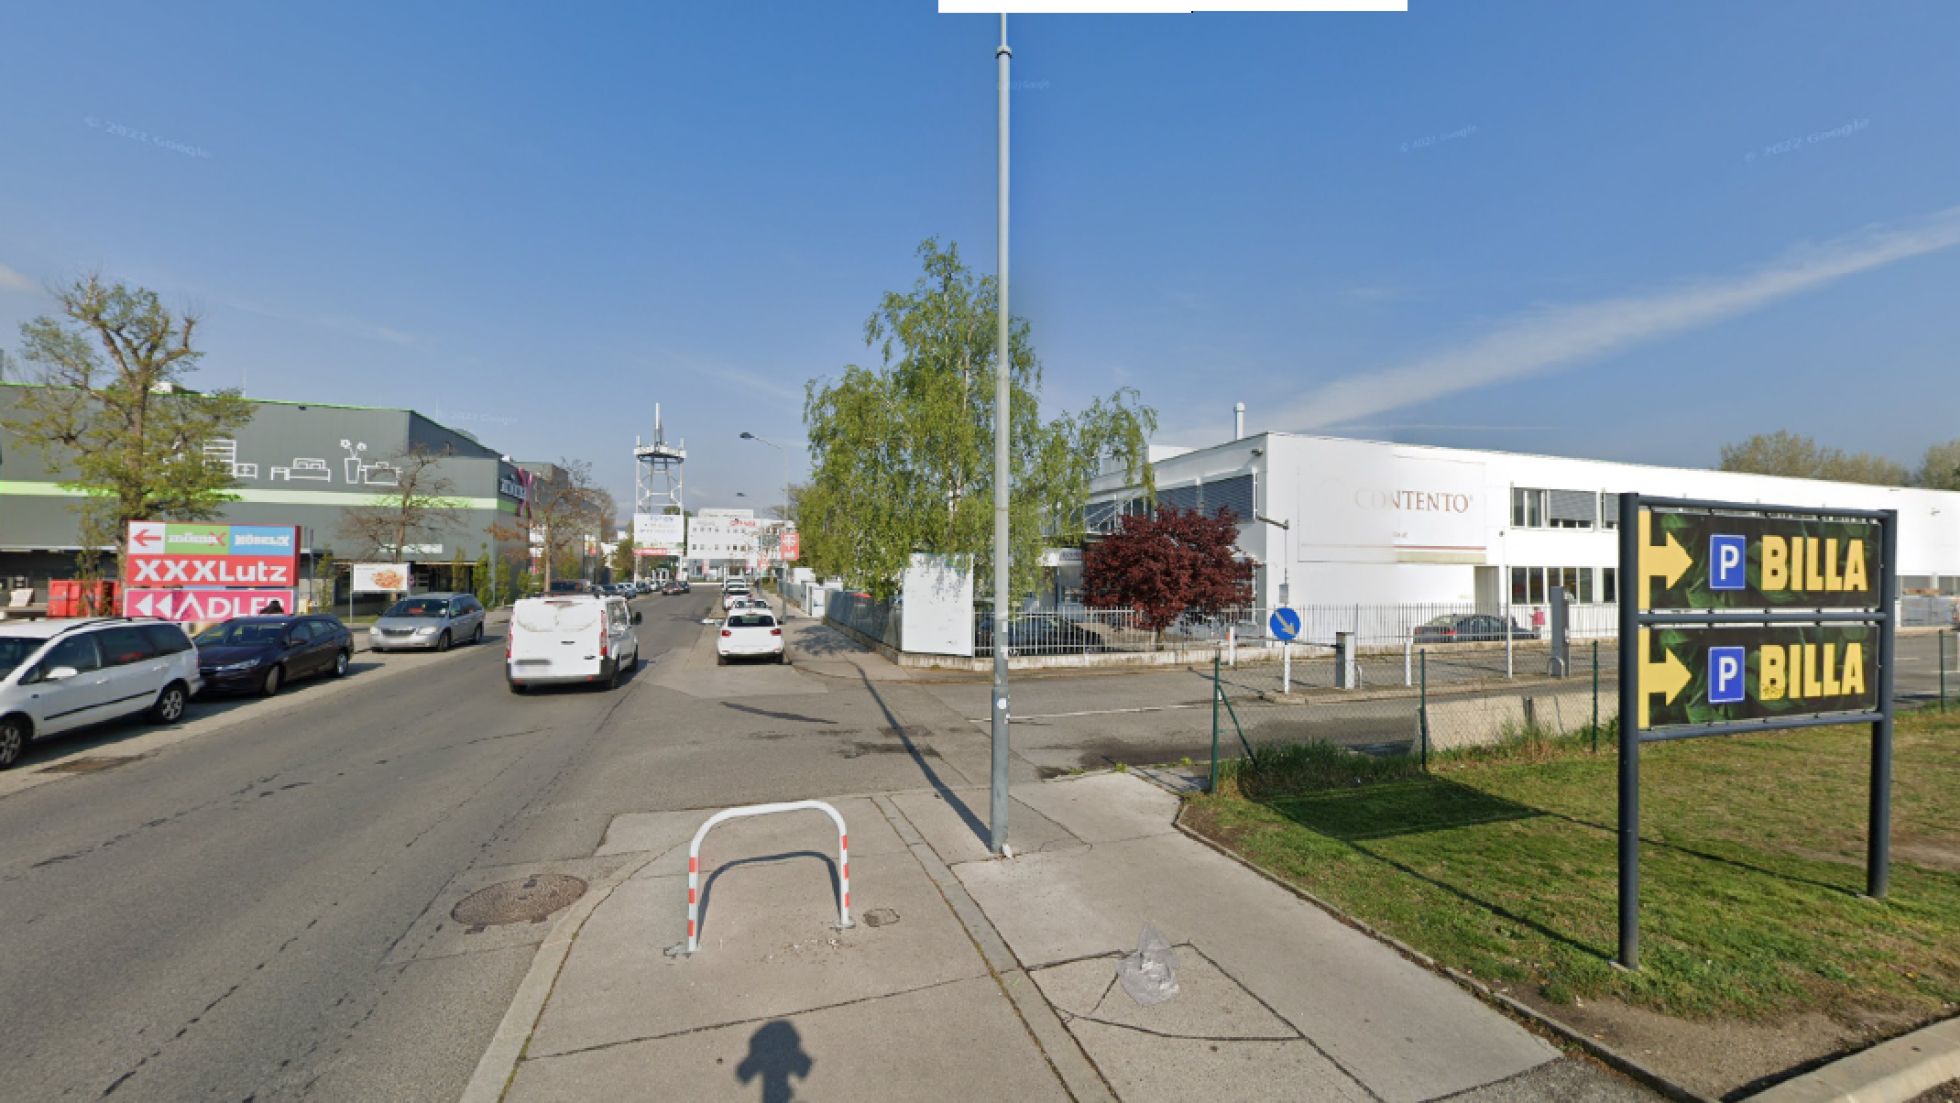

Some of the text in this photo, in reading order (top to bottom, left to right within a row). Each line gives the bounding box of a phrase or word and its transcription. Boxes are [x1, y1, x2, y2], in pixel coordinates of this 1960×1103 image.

[1354, 486, 1470, 514] CONTENTO
[134, 558, 287, 583] XXXLutz
[1720, 534, 1869, 592] P BILLA
[1718, 642, 1866, 701] P BILLA
